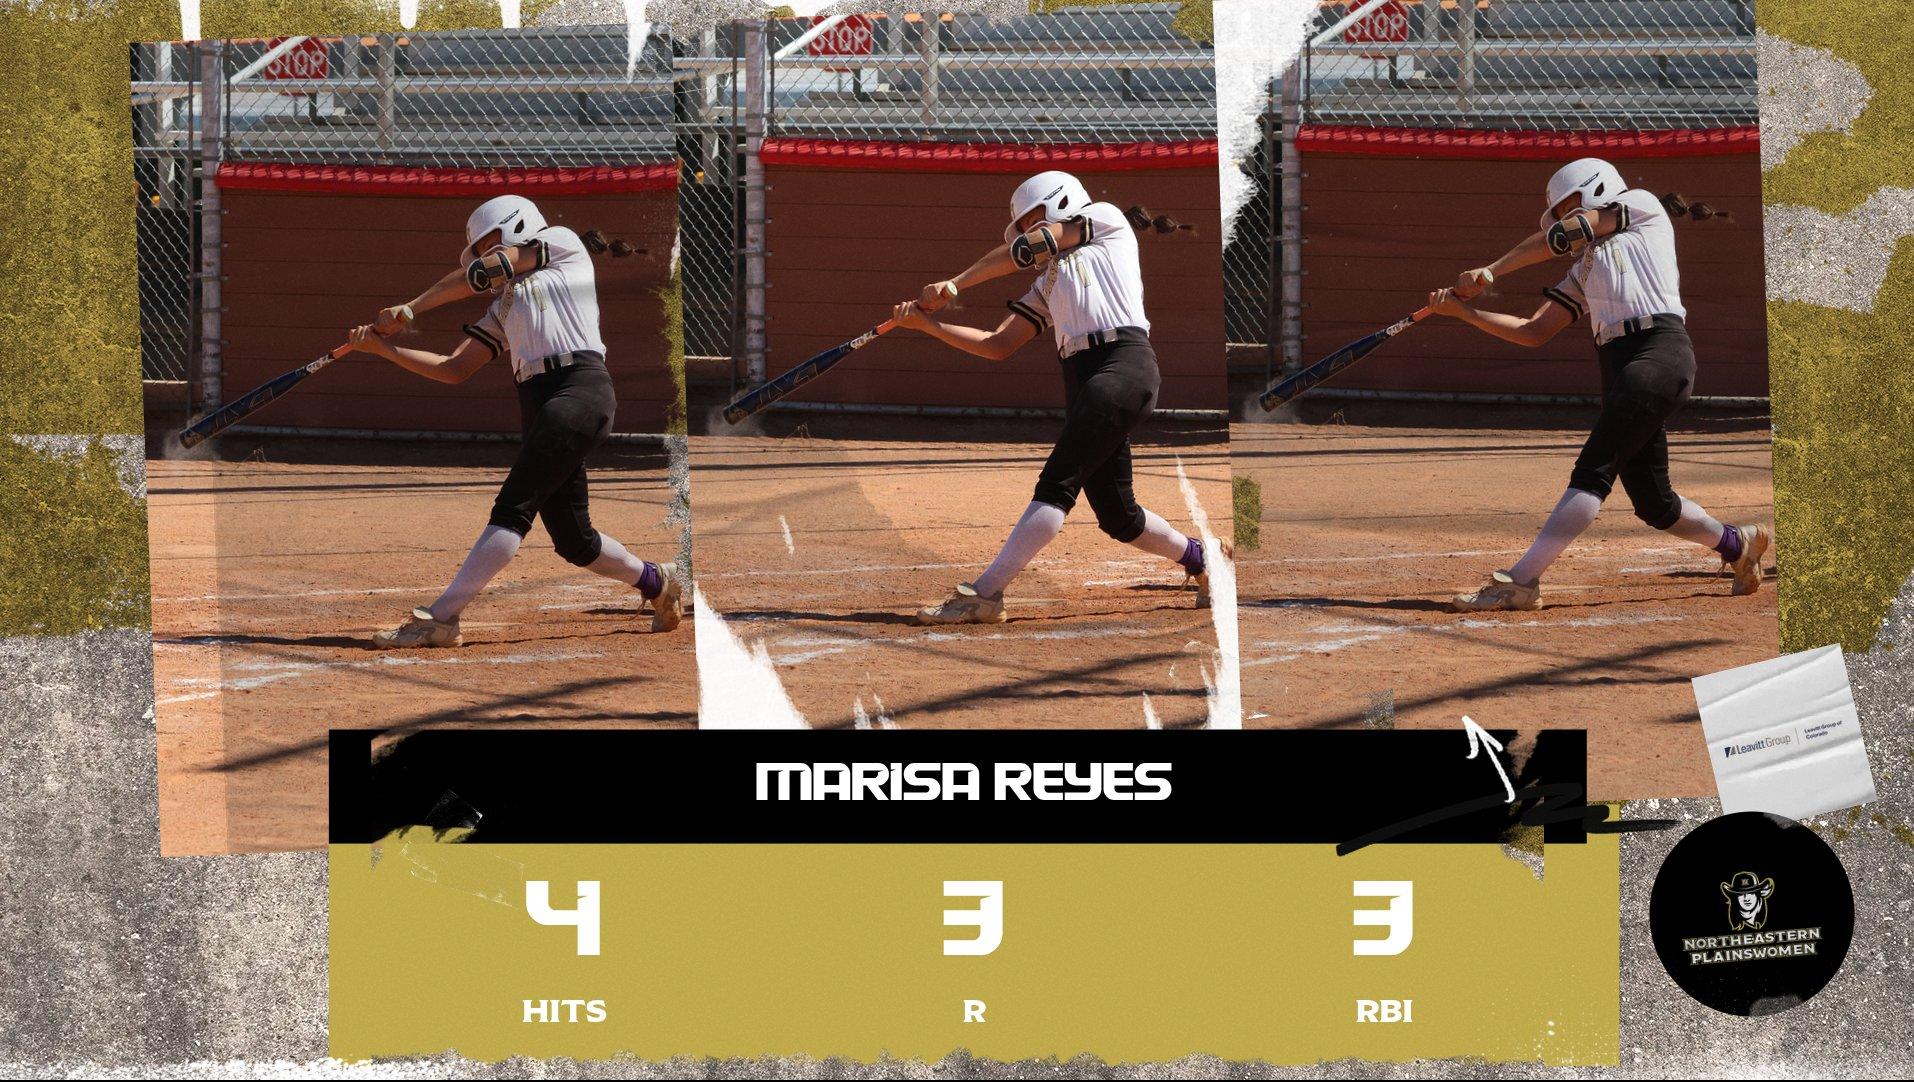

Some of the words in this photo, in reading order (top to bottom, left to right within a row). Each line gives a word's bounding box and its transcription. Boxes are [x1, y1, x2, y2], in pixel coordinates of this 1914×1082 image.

[811, 25, 868, 52] STOP
[1349, 12, 1404, 39] STOP
[268, 48, 325, 75] STOP
